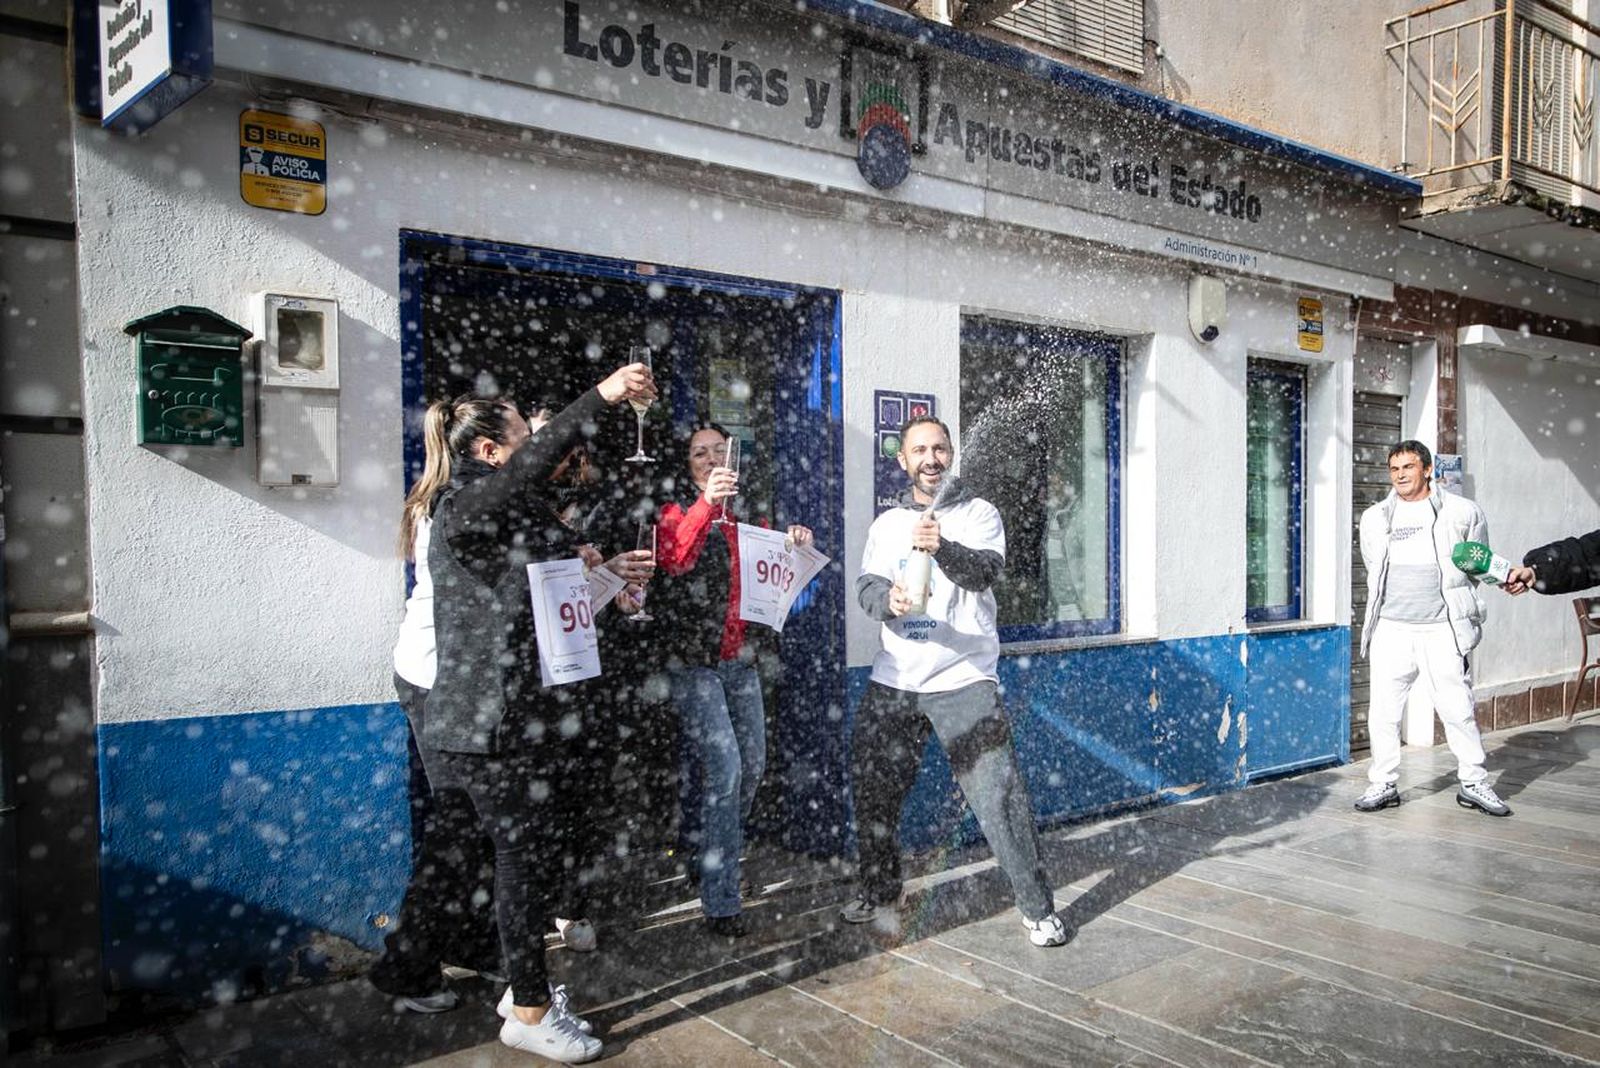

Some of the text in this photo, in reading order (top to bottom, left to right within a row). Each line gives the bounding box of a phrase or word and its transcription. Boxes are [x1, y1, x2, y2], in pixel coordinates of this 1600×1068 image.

[564, 0, 1262, 223] Loterías y Apuestas del Estado
[266, 129, 320, 147] SECUR
[272, 164, 320, 181] POLICIA
[273, 155, 309, 169] AVISO
[1165, 237, 1237, 263] Administración
[560, 600, 593, 632] 90
